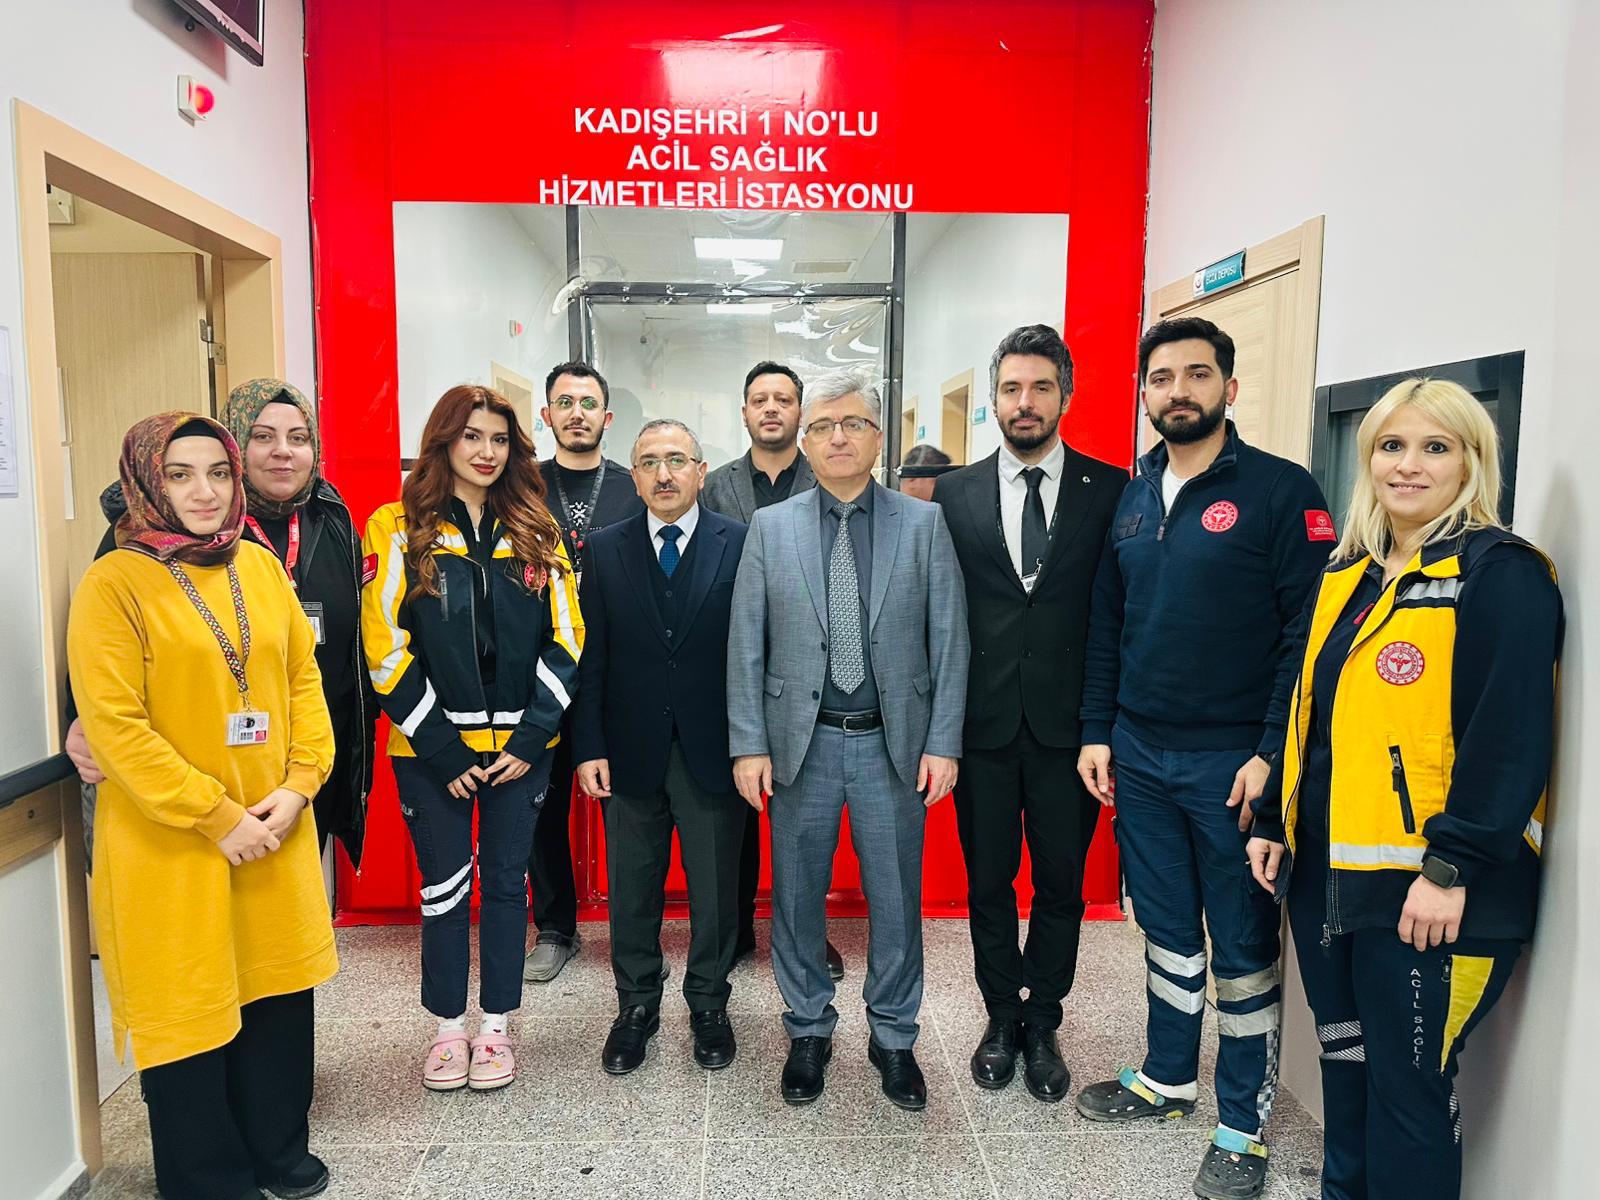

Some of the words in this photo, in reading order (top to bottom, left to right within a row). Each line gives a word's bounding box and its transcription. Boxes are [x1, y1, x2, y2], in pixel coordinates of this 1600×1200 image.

[574, 104, 747, 140] KADIŞEHRİ
[758, 110, 771, 136] 1
[783, 110, 878, 137] NO'LU
[626, 139, 701, 171] ACİL
[710, 140, 828, 172] SAĞLIK
[539, 174, 726, 207] HİZMETLERİ
[737, 177, 914, 209] İSTASYONU
[1410, 968, 1422, 1009] ACİL
